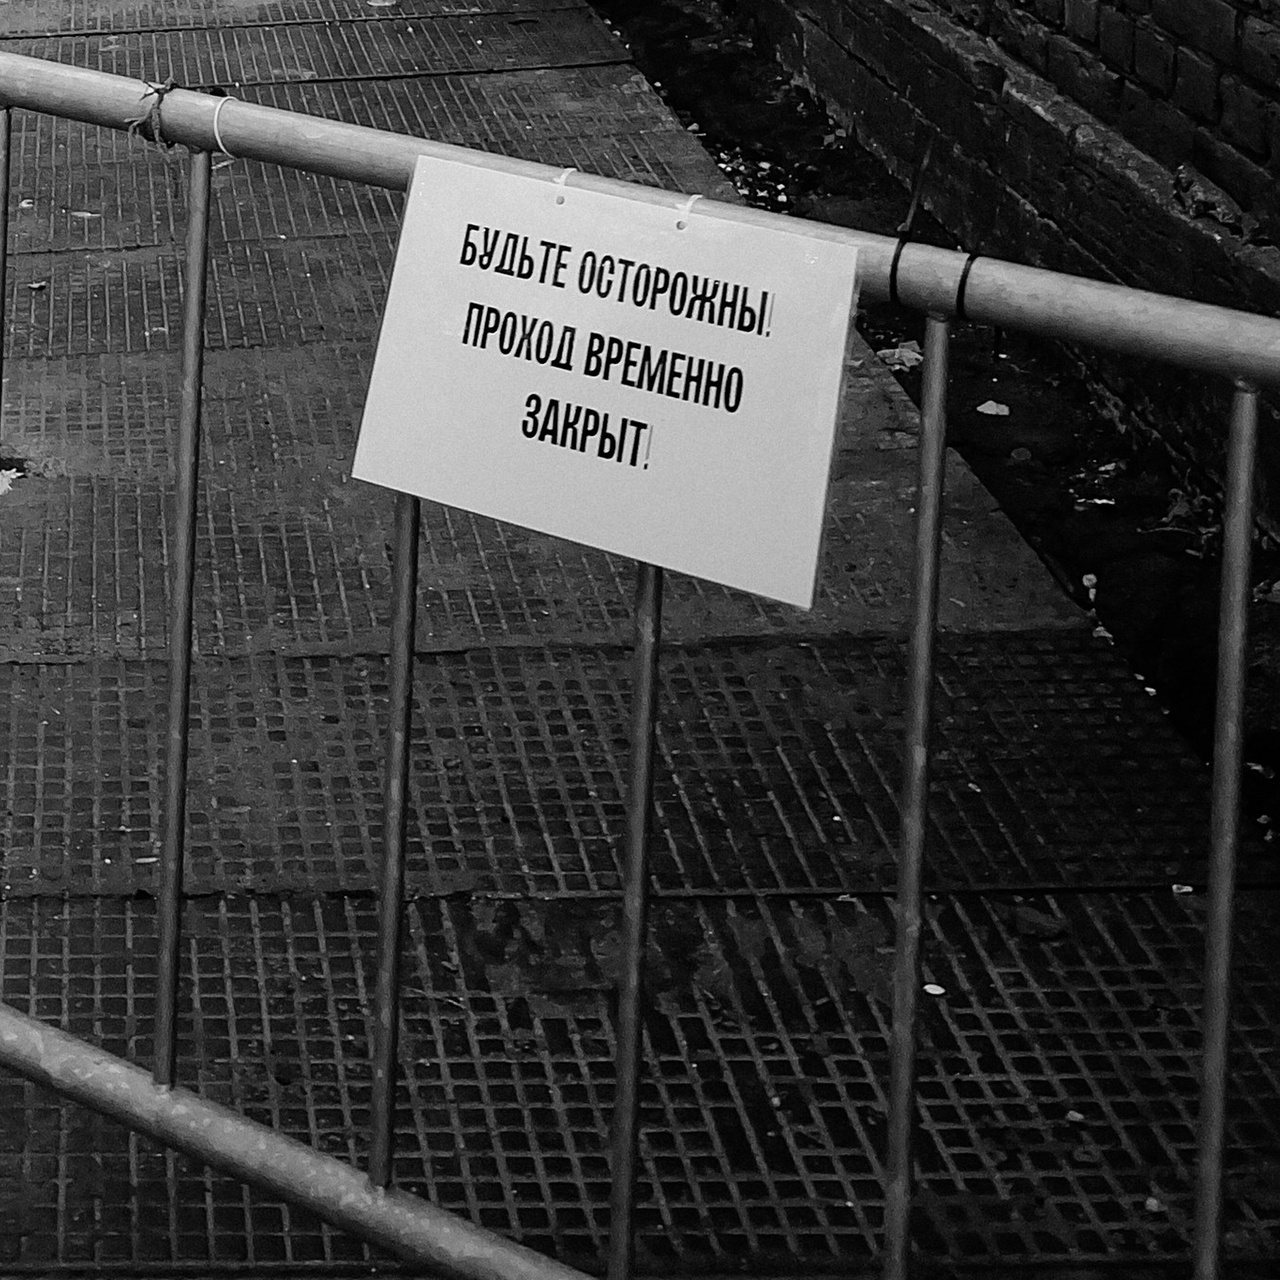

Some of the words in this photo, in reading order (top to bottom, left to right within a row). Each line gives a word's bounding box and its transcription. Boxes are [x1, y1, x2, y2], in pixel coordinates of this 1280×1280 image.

[460, 223, 572, 289] БУДЬТЕ
[578, 251, 776, 338] ОСТОРОЖНЫ!
[462, 301, 577, 372] ПРОХОД
[583, 332, 744, 413] ВРЕМЕННО
[521, 393, 654, 470] ЗАКРЫТ!
